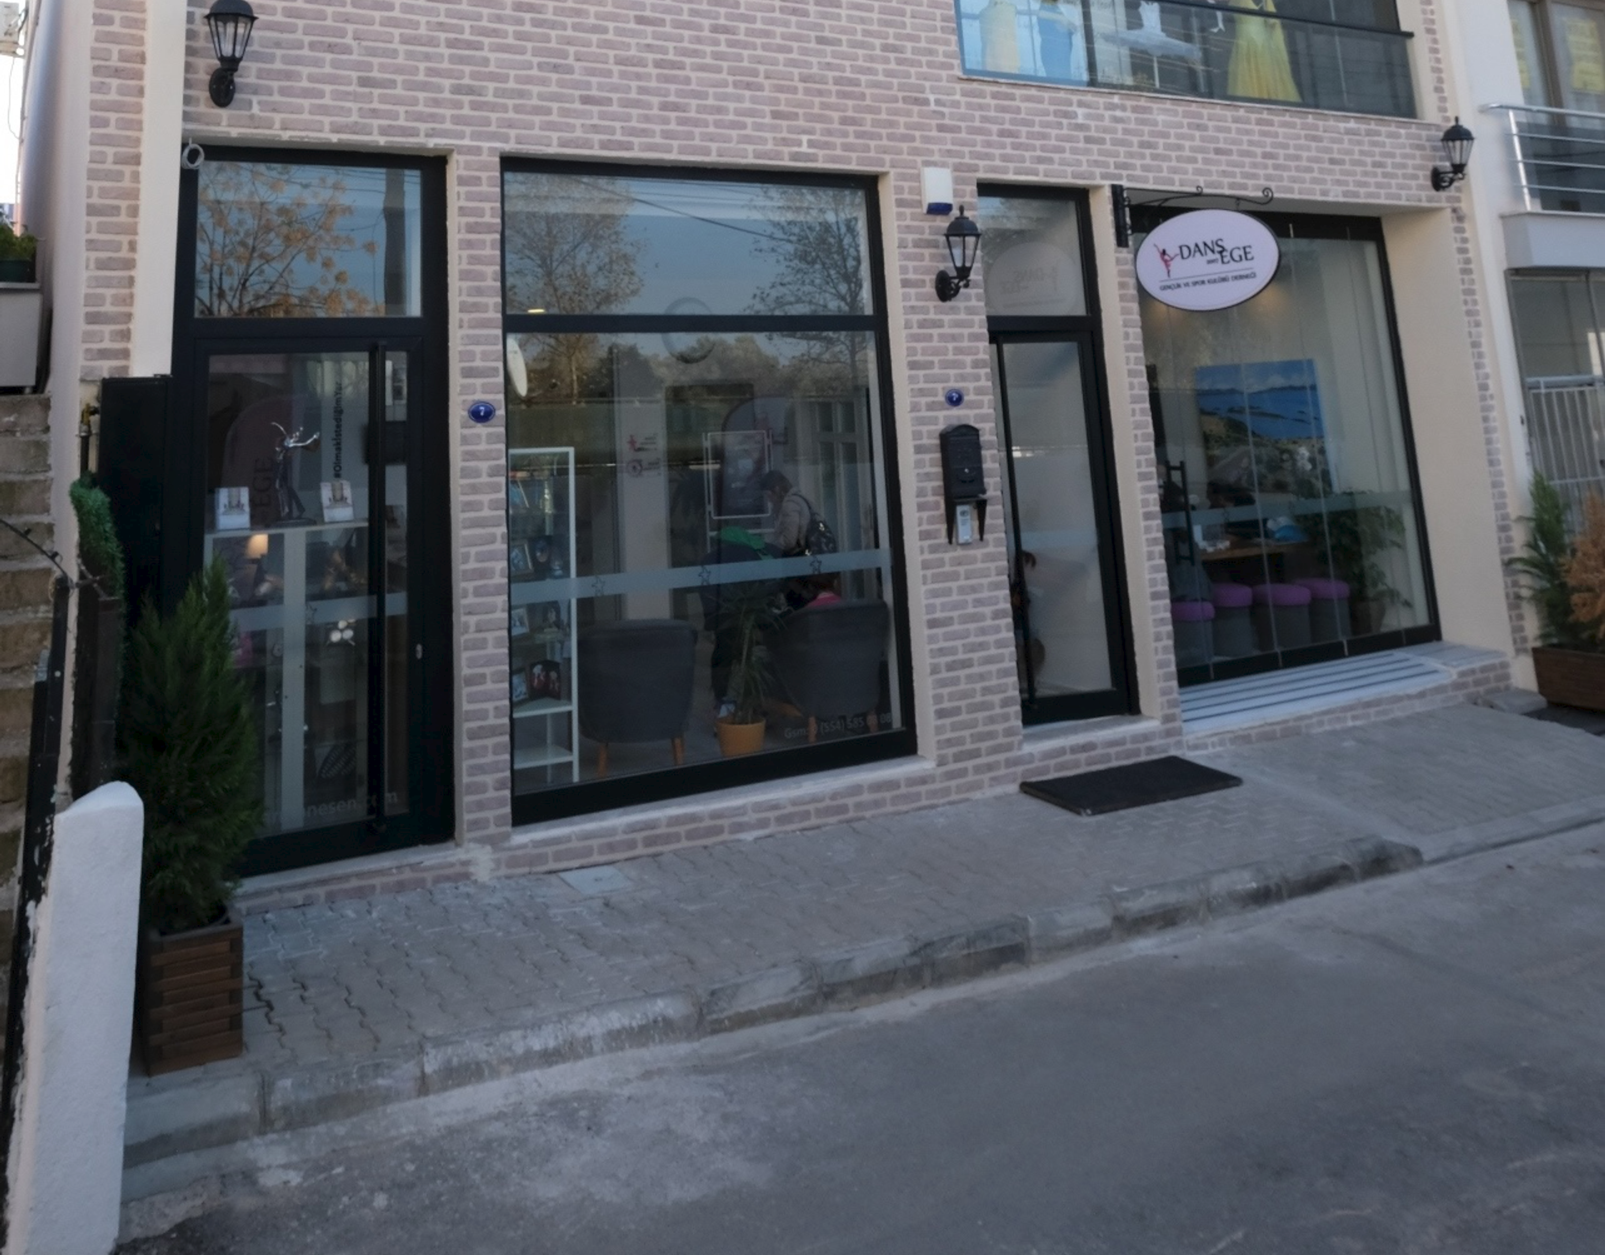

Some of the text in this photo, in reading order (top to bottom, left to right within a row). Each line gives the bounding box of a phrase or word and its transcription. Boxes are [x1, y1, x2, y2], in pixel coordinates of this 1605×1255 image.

[1179, 238, 1226, 261] DANS
[1220, 245, 1255, 265] EGE
[479, 406, 485, 417] 7
